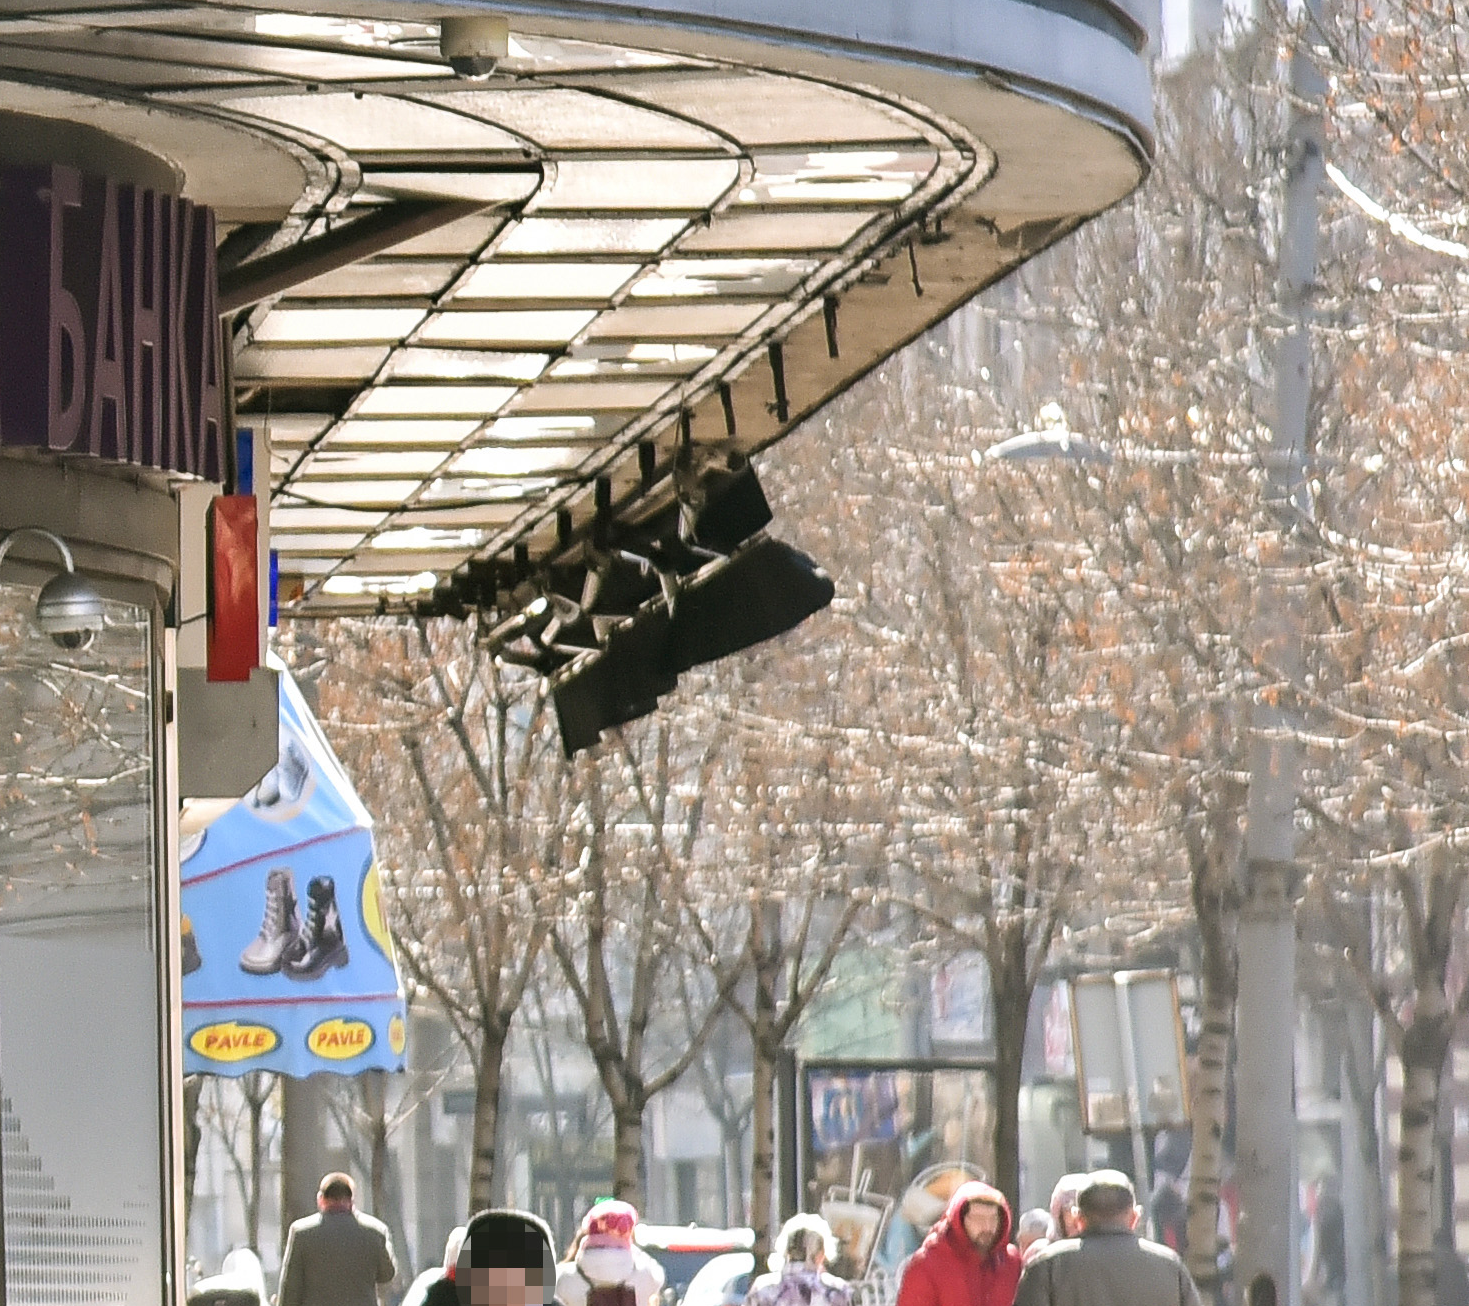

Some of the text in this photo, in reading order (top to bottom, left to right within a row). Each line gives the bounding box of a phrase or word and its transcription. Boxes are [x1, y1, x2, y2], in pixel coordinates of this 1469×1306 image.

[47, 163, 226, 482] БАНКА
[204, 1028, 365, 1050] PAVLE PAVLE
